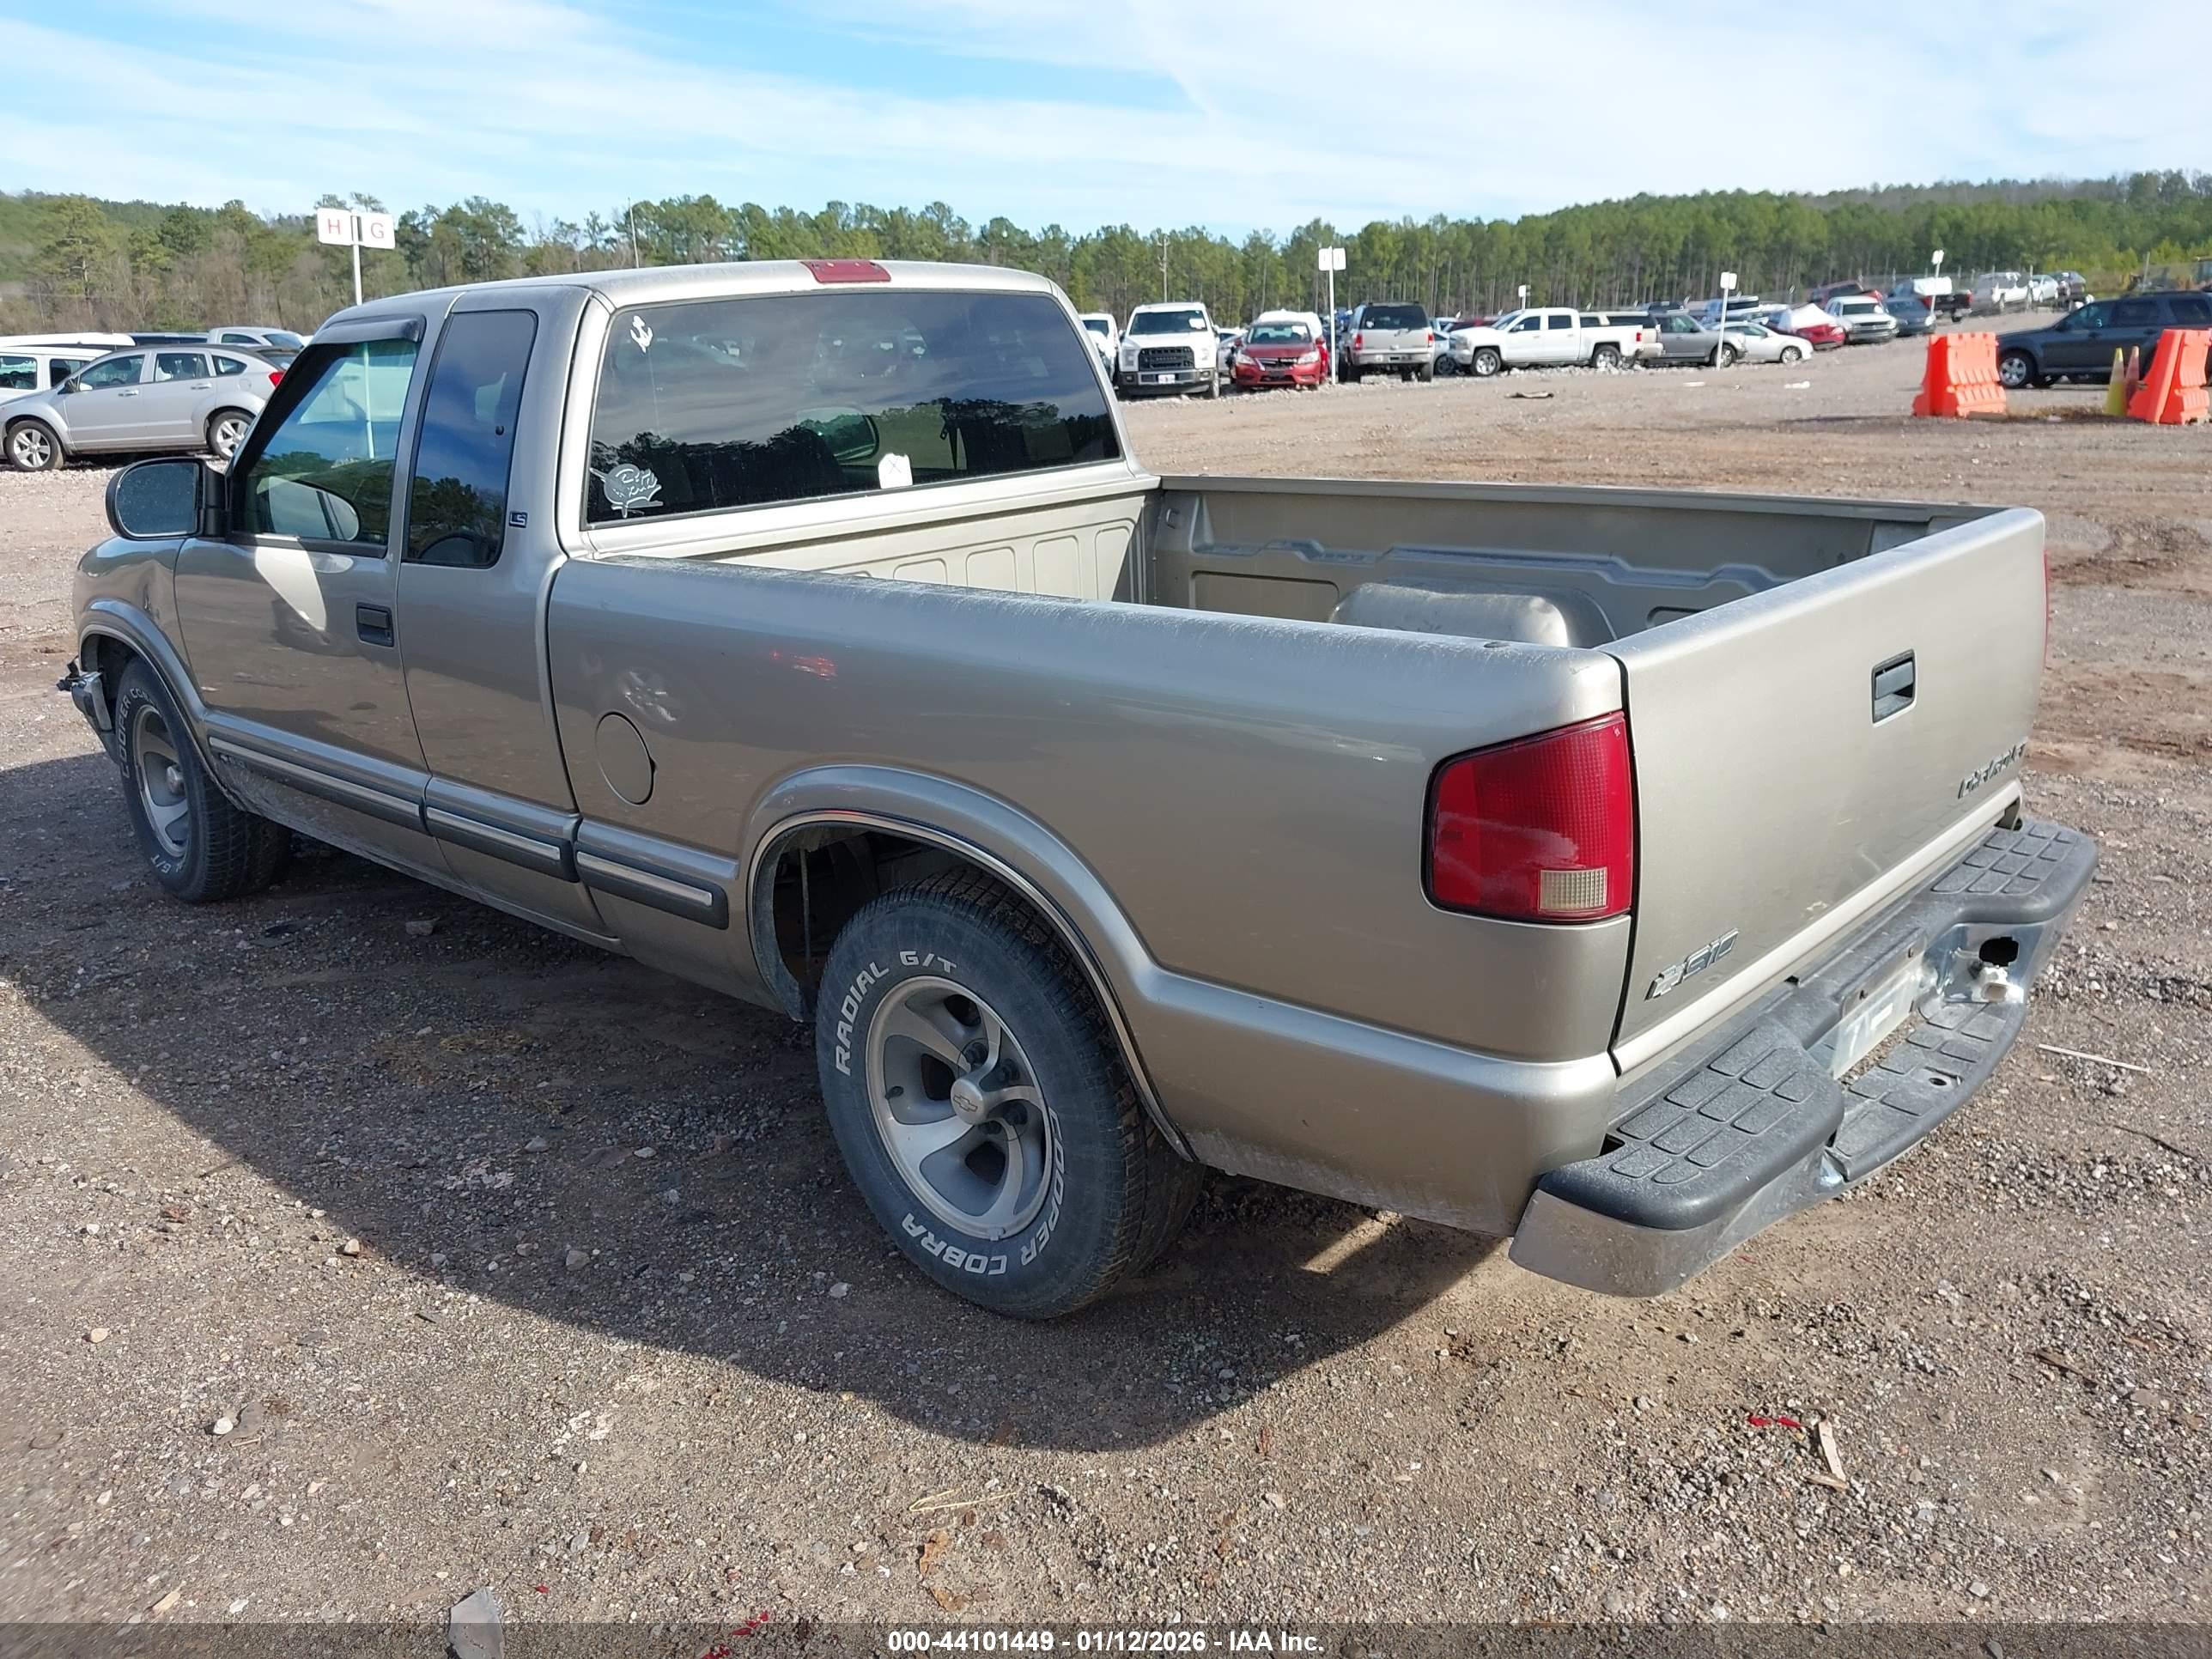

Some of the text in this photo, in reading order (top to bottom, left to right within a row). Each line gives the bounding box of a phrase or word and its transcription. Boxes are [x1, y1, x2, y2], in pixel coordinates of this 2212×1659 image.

[327, 218, 342, 235] H
[370, 222, 385, 240] G
[835, 950, 957, 1077] RADIAL G/T
[902, 1106, 1066, 1276] COOPER COBRA
